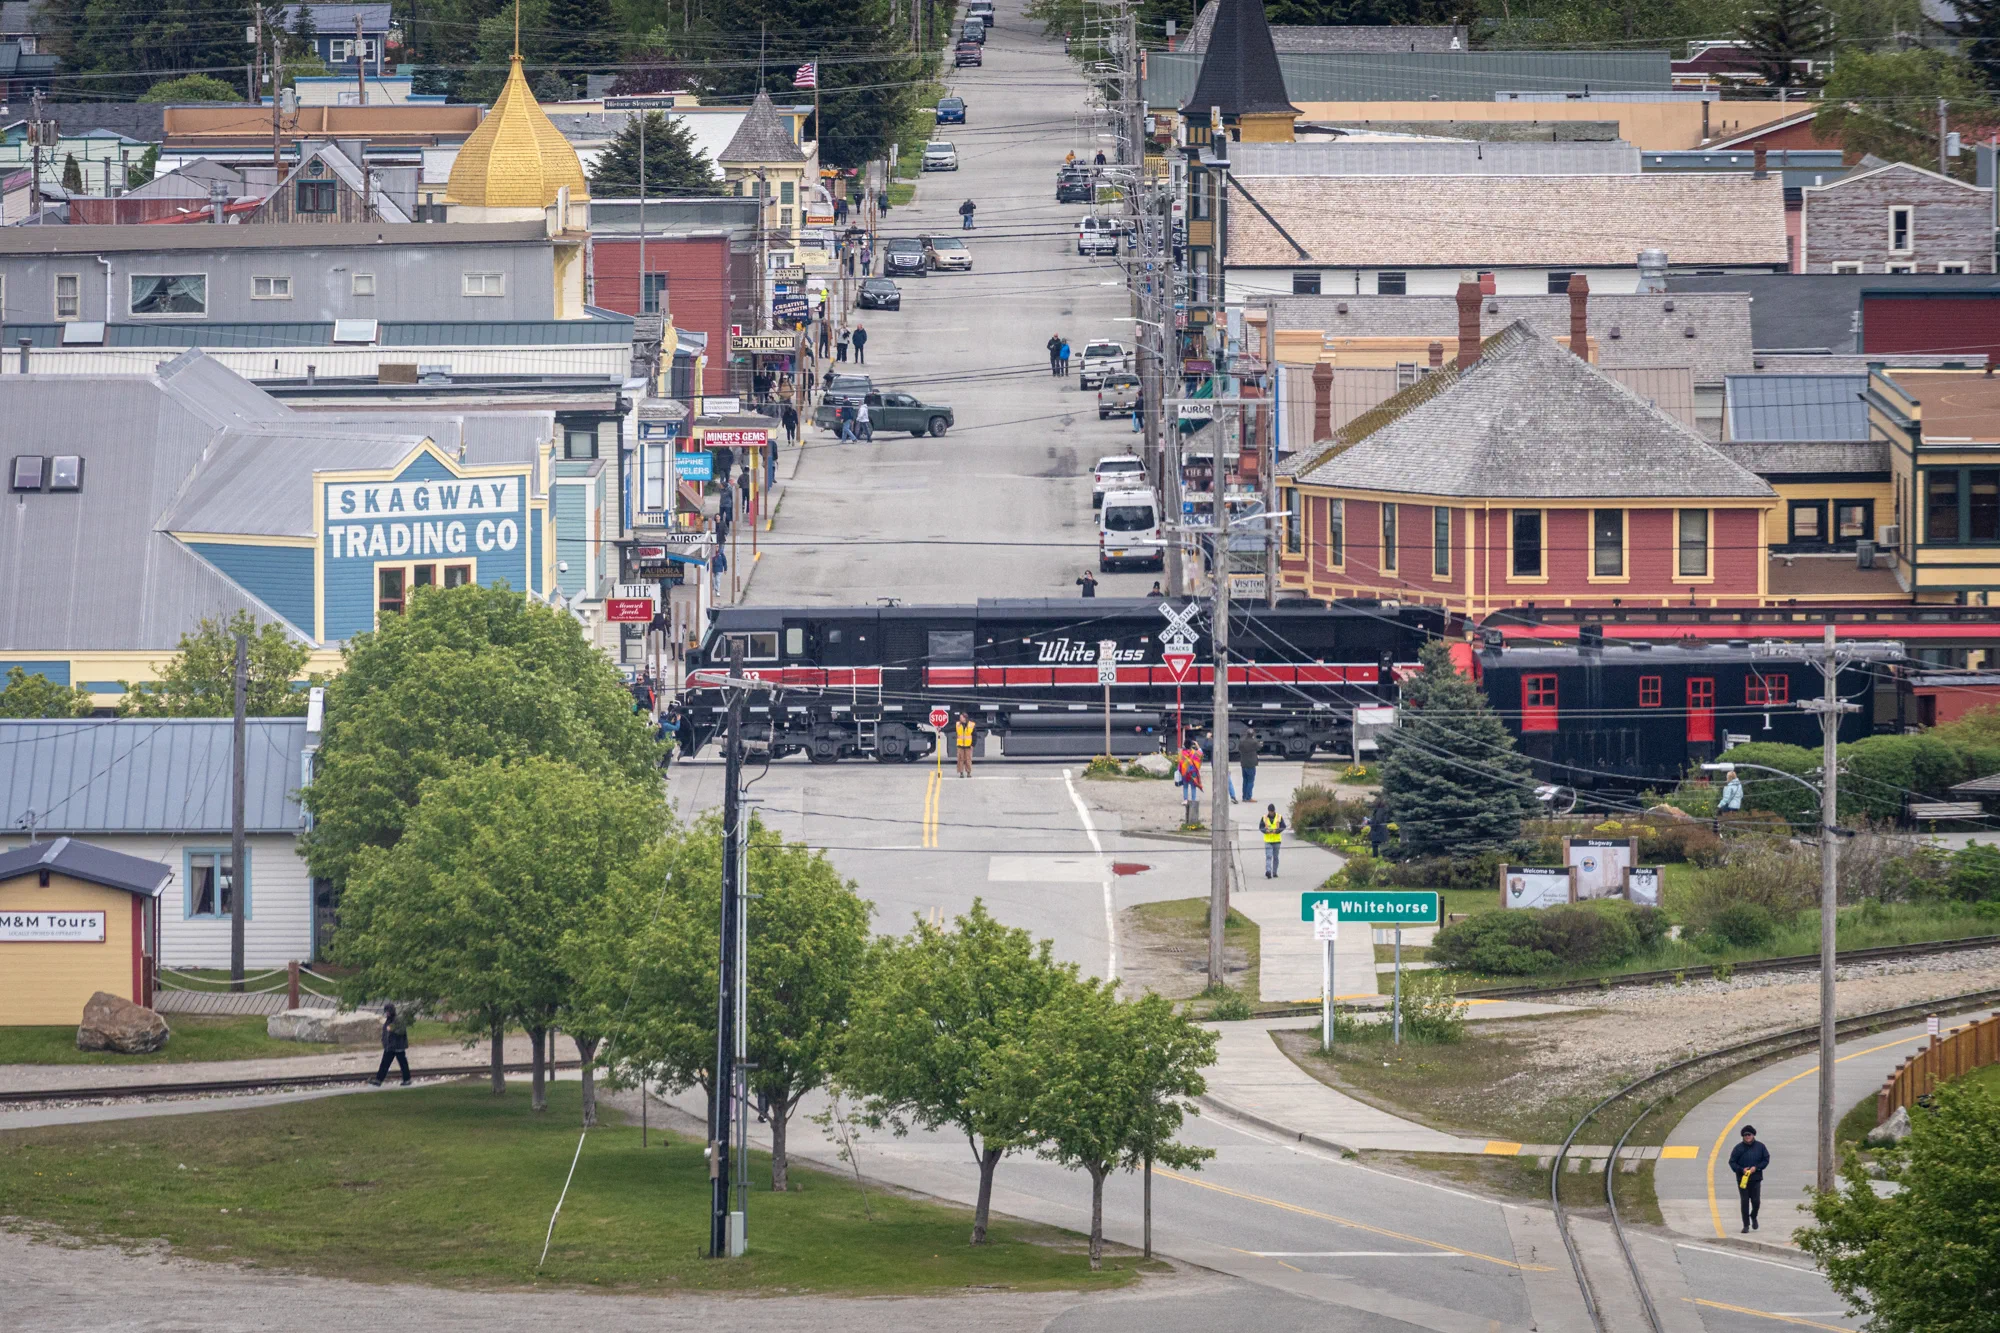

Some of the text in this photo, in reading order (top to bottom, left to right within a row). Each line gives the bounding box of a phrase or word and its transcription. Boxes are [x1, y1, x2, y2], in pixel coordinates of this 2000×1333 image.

[775, 300, 805, 310] CREATIVE
[773, 305, 808, 316] GOLDSMITH
[742, 337, 793, 348] PANTHEON
[1181, 405, 1212, 414] AUROR
[706, 432, 765, 441] MINER'S GEMS
[676, 467, 710, 475] WELERS
[1185, 468, 1202, 477] THE
[340, 483, 507, 514] SKAGWAY
[328, 518, 519, 559] TRADING CO
[670, 534, 713, 544] AURO
[1234, 579, 1264, 588] VISITOR
[624, 585, 651, 598] THE
[620, 608, 639, 616] Jewels
[1035, 637, 1096, 661] White
[1099, 671, 1115, 681] 20
[930, 714, 947, 722] STOP
[1340, 900, 1429, 914] Whitehorse
[0, 916, 97, 928] M&M Tours
